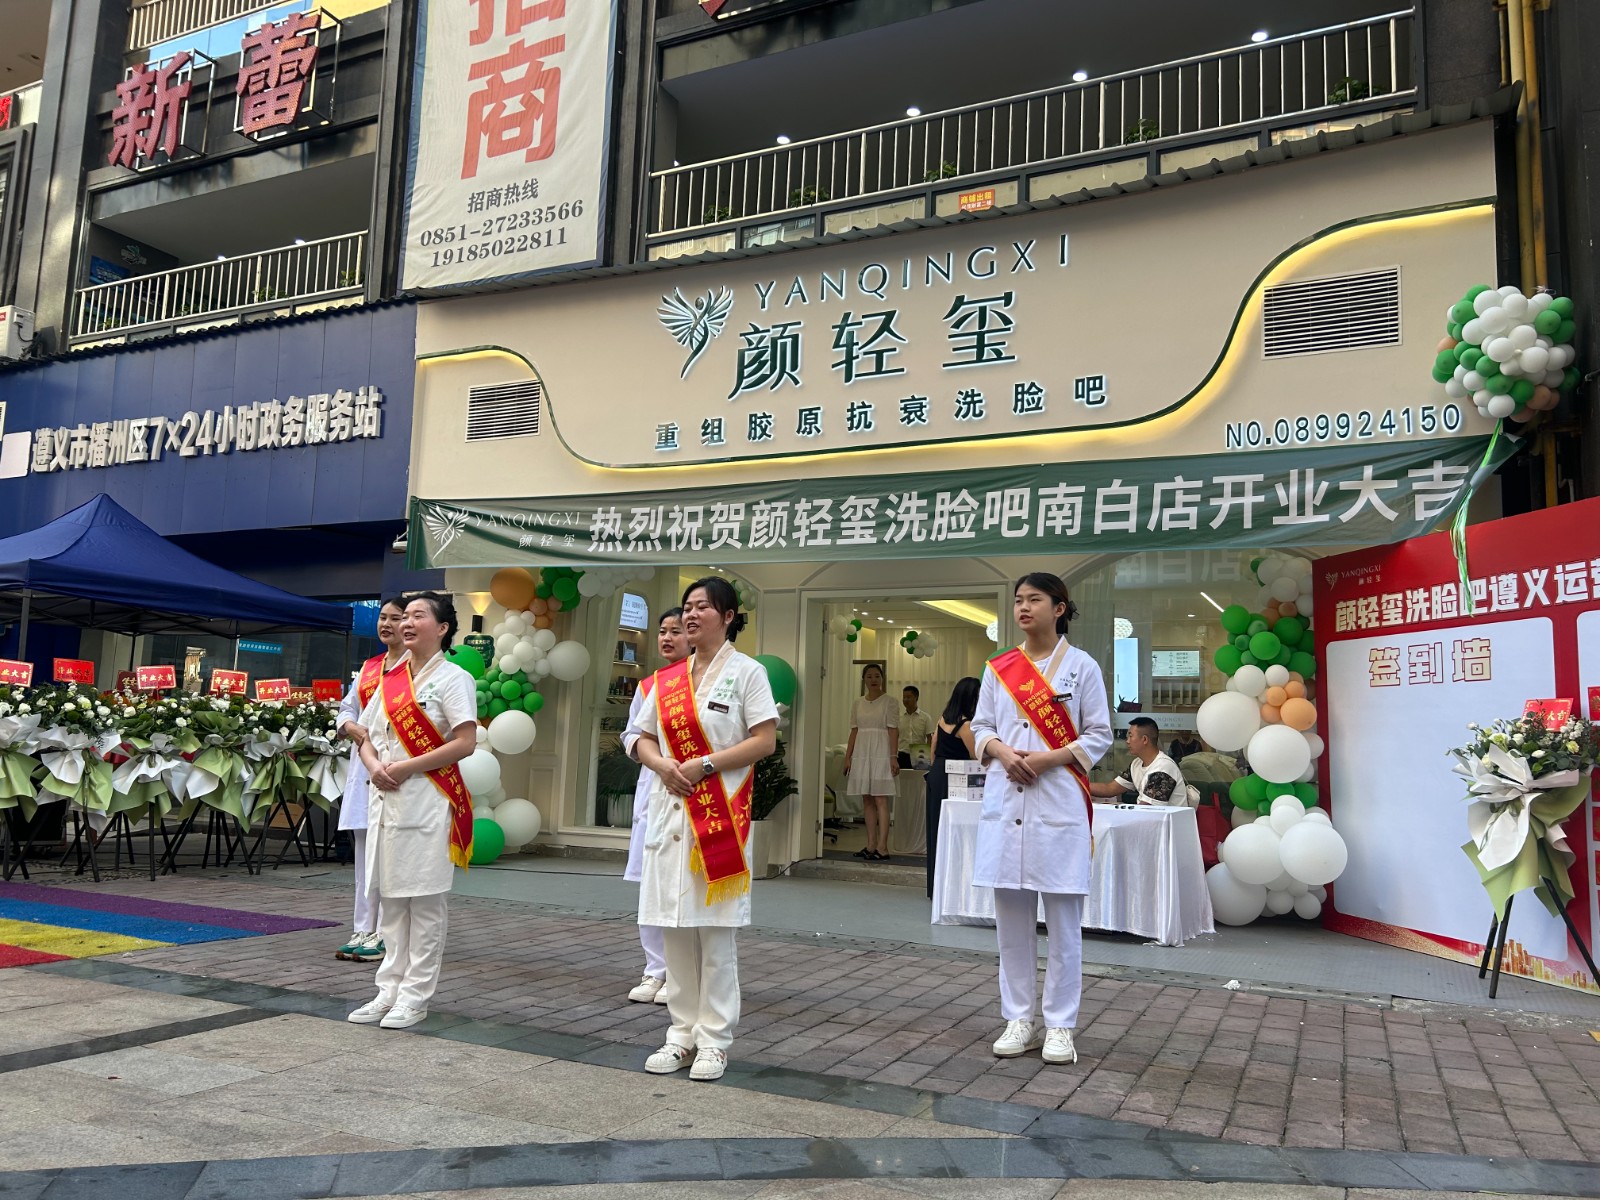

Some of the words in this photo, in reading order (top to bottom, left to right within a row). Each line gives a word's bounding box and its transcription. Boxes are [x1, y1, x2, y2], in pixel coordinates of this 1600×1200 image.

[107, 13, 321, 168] 新蕾
[467, 178, 540, 214] 招商热线
[420, 199, 584, 247] 0851-27233566
[431, 226, 568, 268] 19185022811
[753, 233, 1069, 311] YANQINGXI
[727, 290, 1017, 401] 颜轻玺
[654, 374, 1106, 451] 重组胶原抗衰洗脸吧
[1225, 403, 1462, 449] NO.089924150
[475, 511, 581, 530] YANQINGXI
[587, 459, 1469, 554] 热烈祝贺颜轻玺洗脸吧南白店开业大吉
[519, 533, 575, 548] 颜轻玺
[1341, 563, 1382, 579] YANQINGXI
[141, 674, 174, 684] 开业大吉
[1368, 637, 1492, 688] 签到墙
[259, 686, 288, 695] 开业大吉
